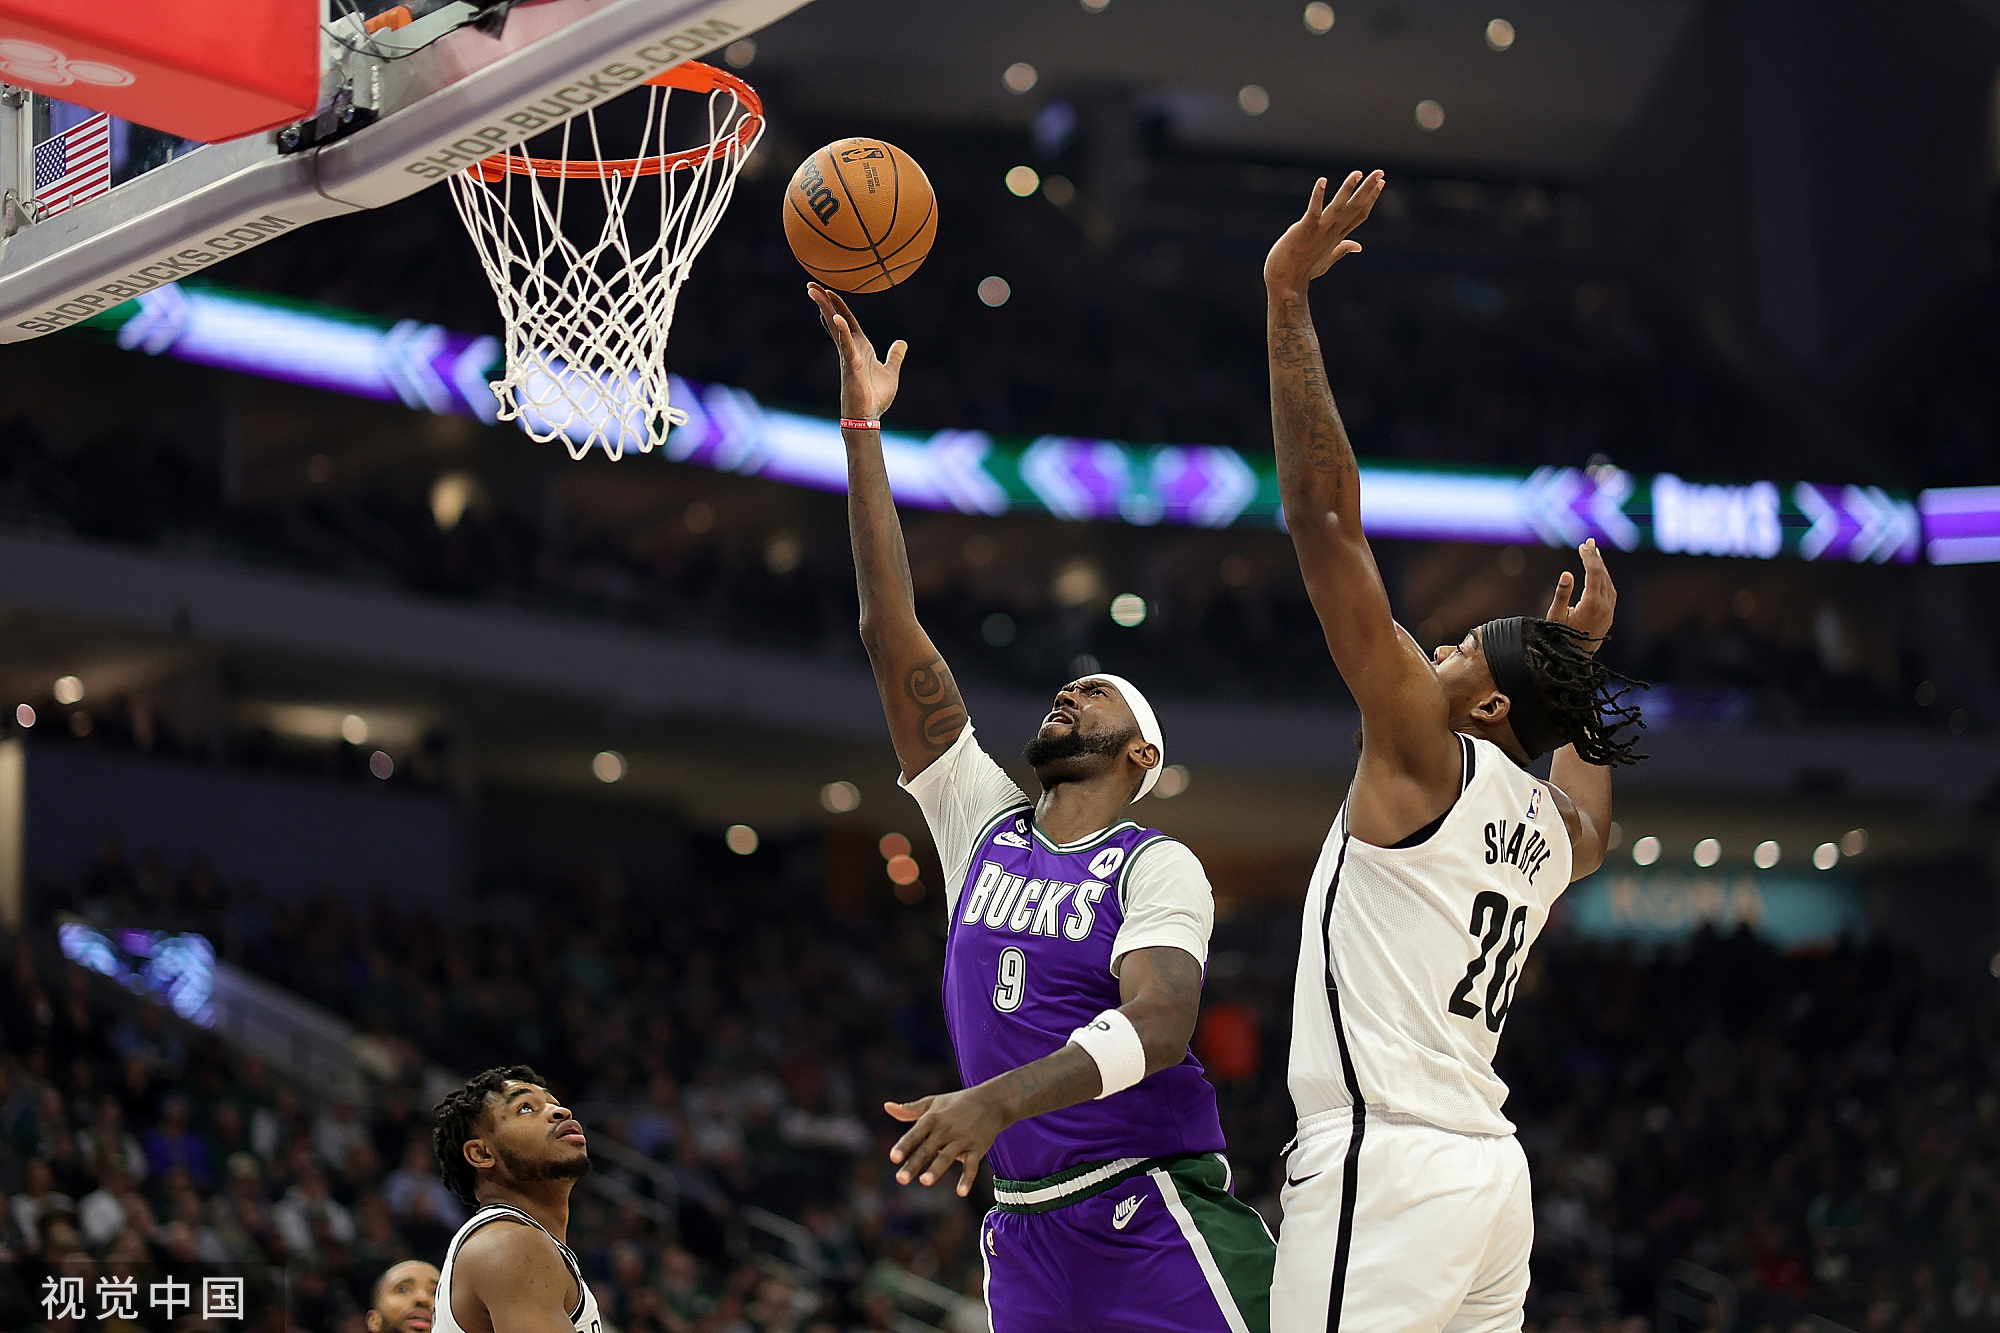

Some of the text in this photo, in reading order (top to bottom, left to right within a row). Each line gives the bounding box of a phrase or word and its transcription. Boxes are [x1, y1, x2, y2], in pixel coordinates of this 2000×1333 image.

[404, 18, 742, 179] SHOP.BUCKS.COM
[800, 156, 840, 226] Wilso
[17, 215, 296, 333] SHOP.BUCKS.COM
[1484, 819, 1551, 886] SHARPE
[961, 860, 1112, 942] BUCKS
[992, 946, 1027, 1013] 9
[1448, 890, 1529, 1034] 20
[1115, 1194, 1137, 1220] NIKE
